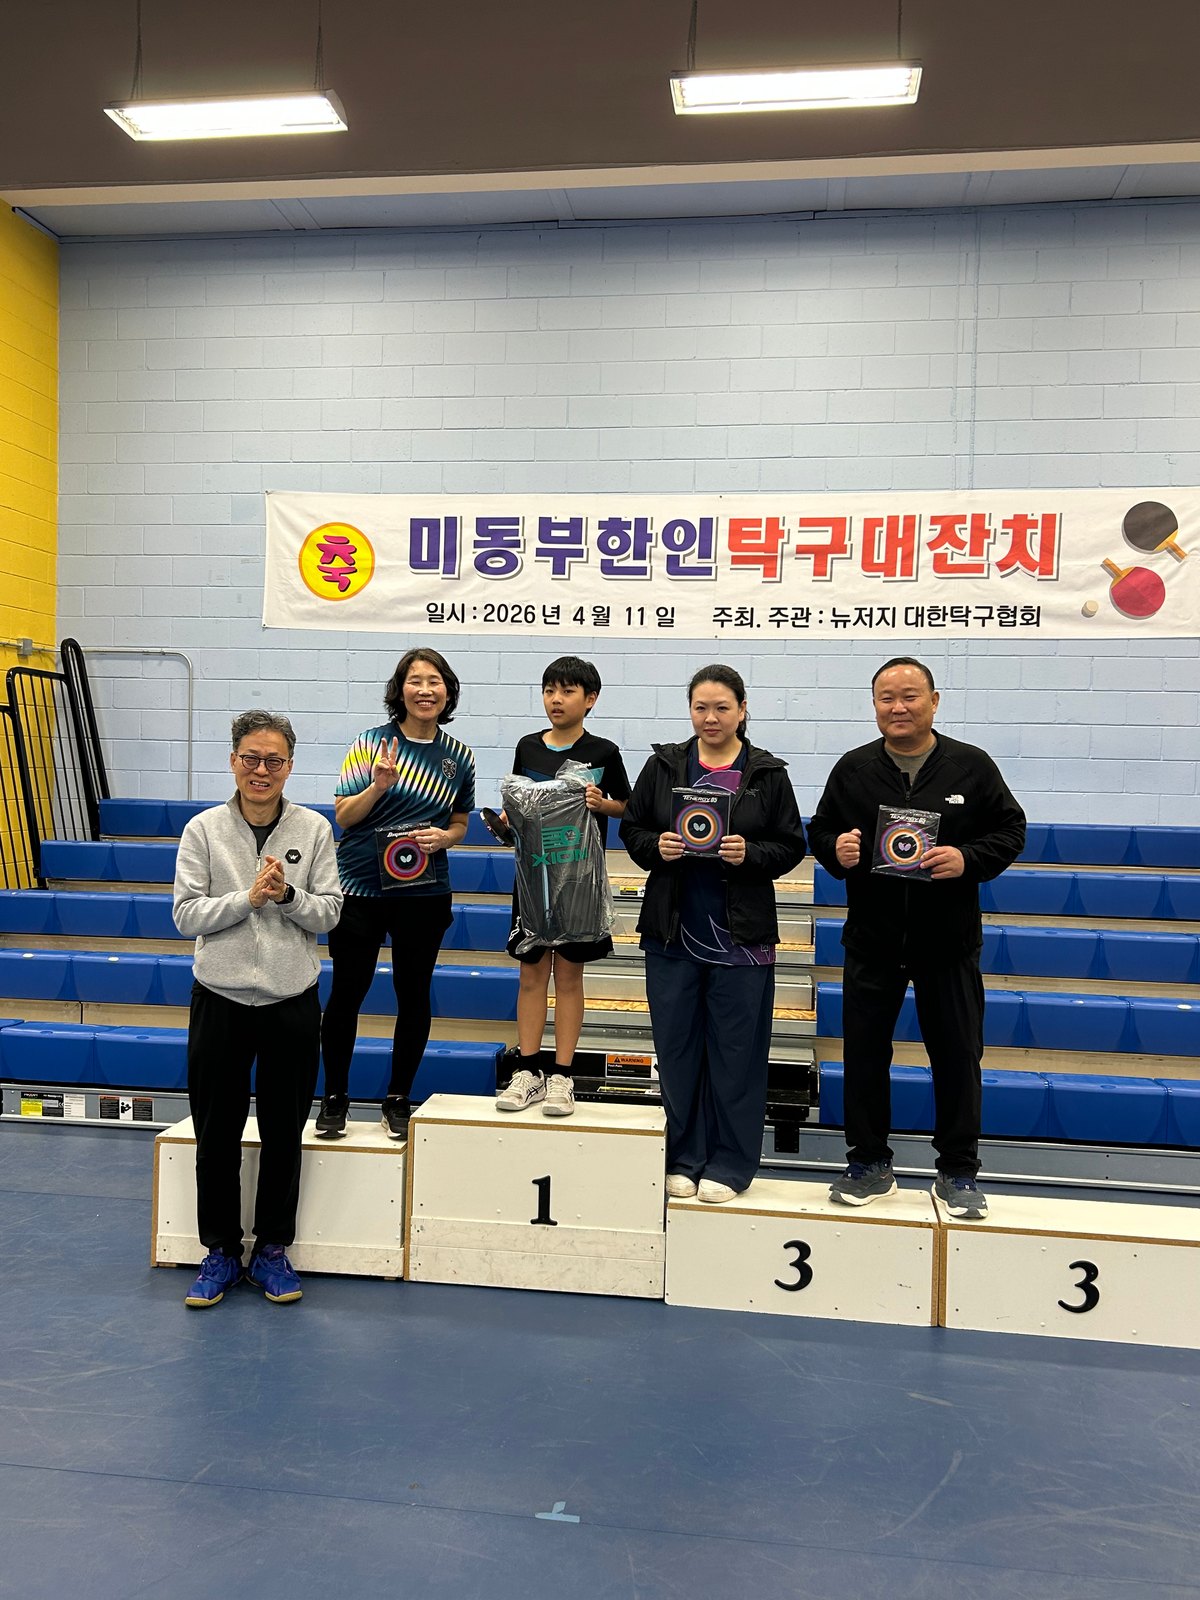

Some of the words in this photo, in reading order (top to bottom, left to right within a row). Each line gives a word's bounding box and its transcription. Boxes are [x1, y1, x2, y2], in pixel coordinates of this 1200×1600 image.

[317, 535, 357, 592] 축
[426, 602, 465, 624] 일시
[483, 603, 536, 624] 2026
[572, 606, 586, 626] 4
[625, 606, 645, 626] 11
[655, 606, 675, 628] 일
[768, 606, 812, 629] 주관
[830, 606, 896, 629] 뉴저지
[904, 605, 1041, 629] 대한탁구협회
[531, 847, 589, 868] XIOM
[530, 1175, 558, 1227] 1
[774, 1240, 813, 1292] 3
[1057, 1260, 1100, 1314] 3
